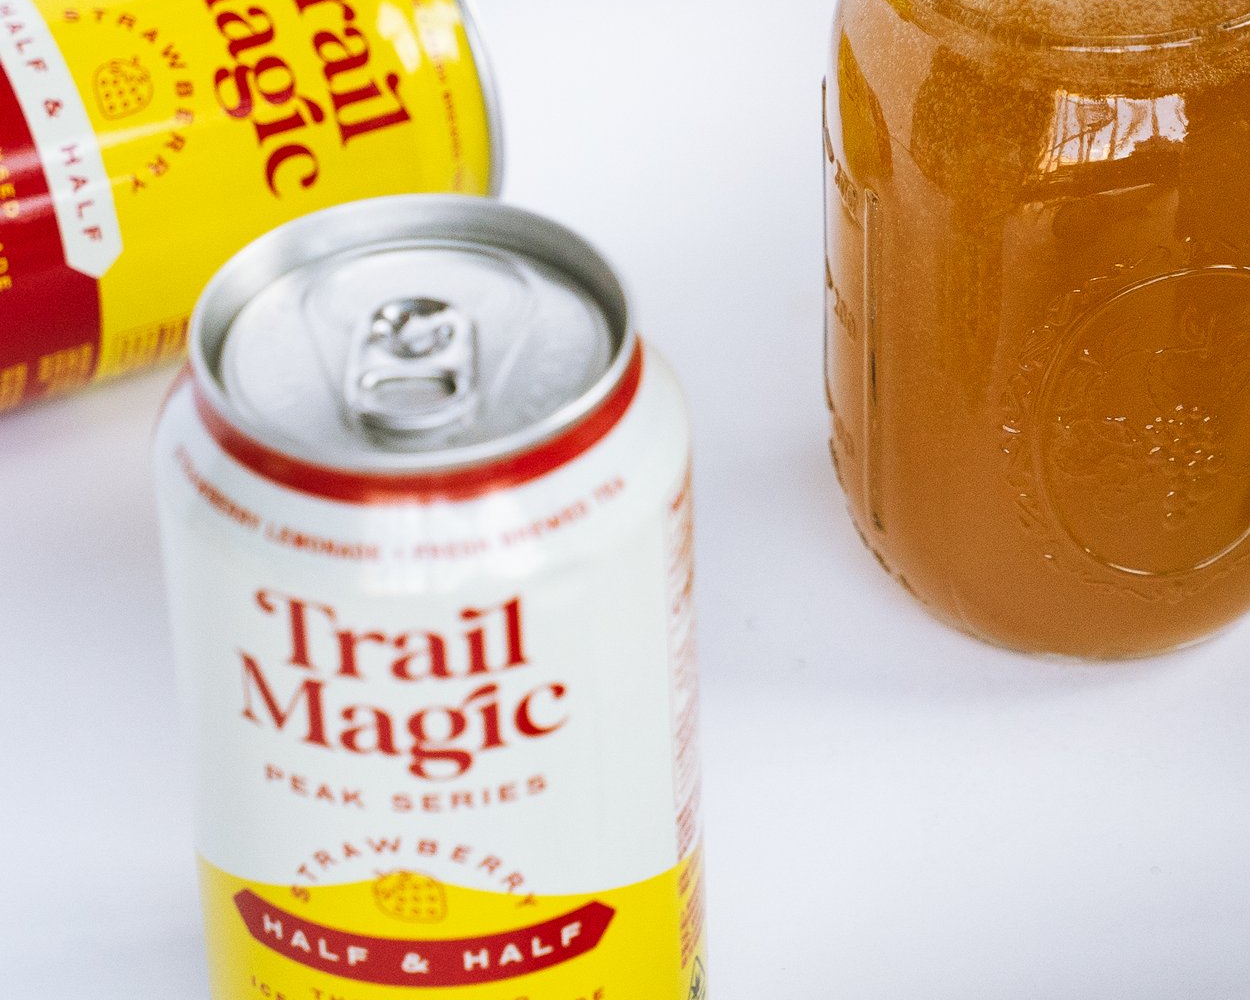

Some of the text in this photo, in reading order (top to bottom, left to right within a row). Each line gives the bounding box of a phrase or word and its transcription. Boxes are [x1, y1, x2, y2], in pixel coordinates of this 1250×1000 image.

[63, 6, 195, 195] STRAWBERRY
[43, 98, 64, 120] &
[60, 142, 104, 244] HALF
[255, 588, 530, 682] Trail
[236, 651, 570, 782] Magic
[265, 764, 548, 813] PEAK SERIES
[291, 837, 540, 909] STRAWBERRY
[262, 914, 582, 974] HALF & HALF
